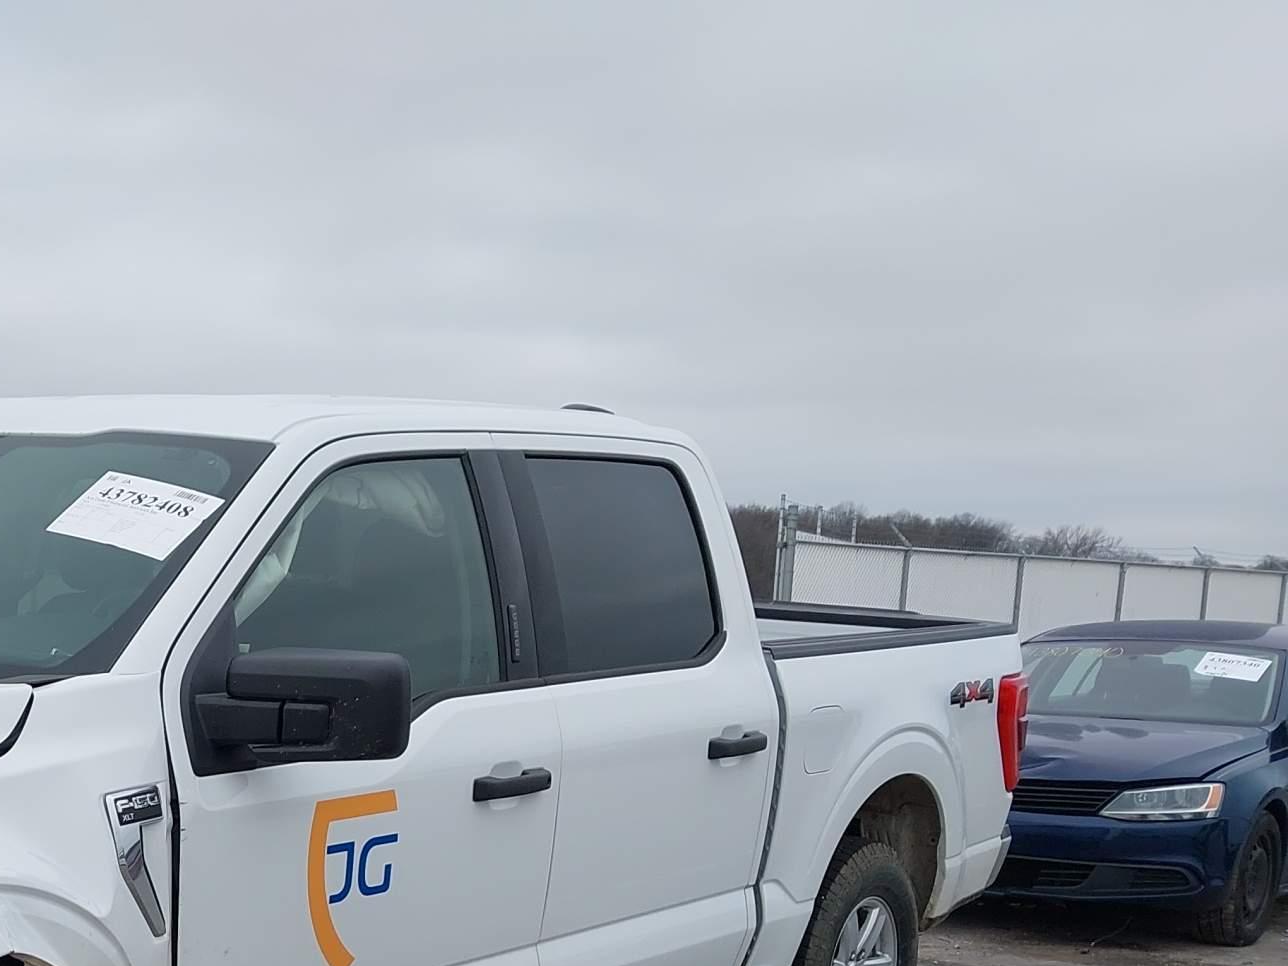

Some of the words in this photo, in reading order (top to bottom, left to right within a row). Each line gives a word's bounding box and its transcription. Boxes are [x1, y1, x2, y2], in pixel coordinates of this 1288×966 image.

[99, 487, 195, 518] 43782408
[116, 792, 159, 813] F-150
[122, 812, 135, 823] XLT
[326, 833, 398, 904] JG
